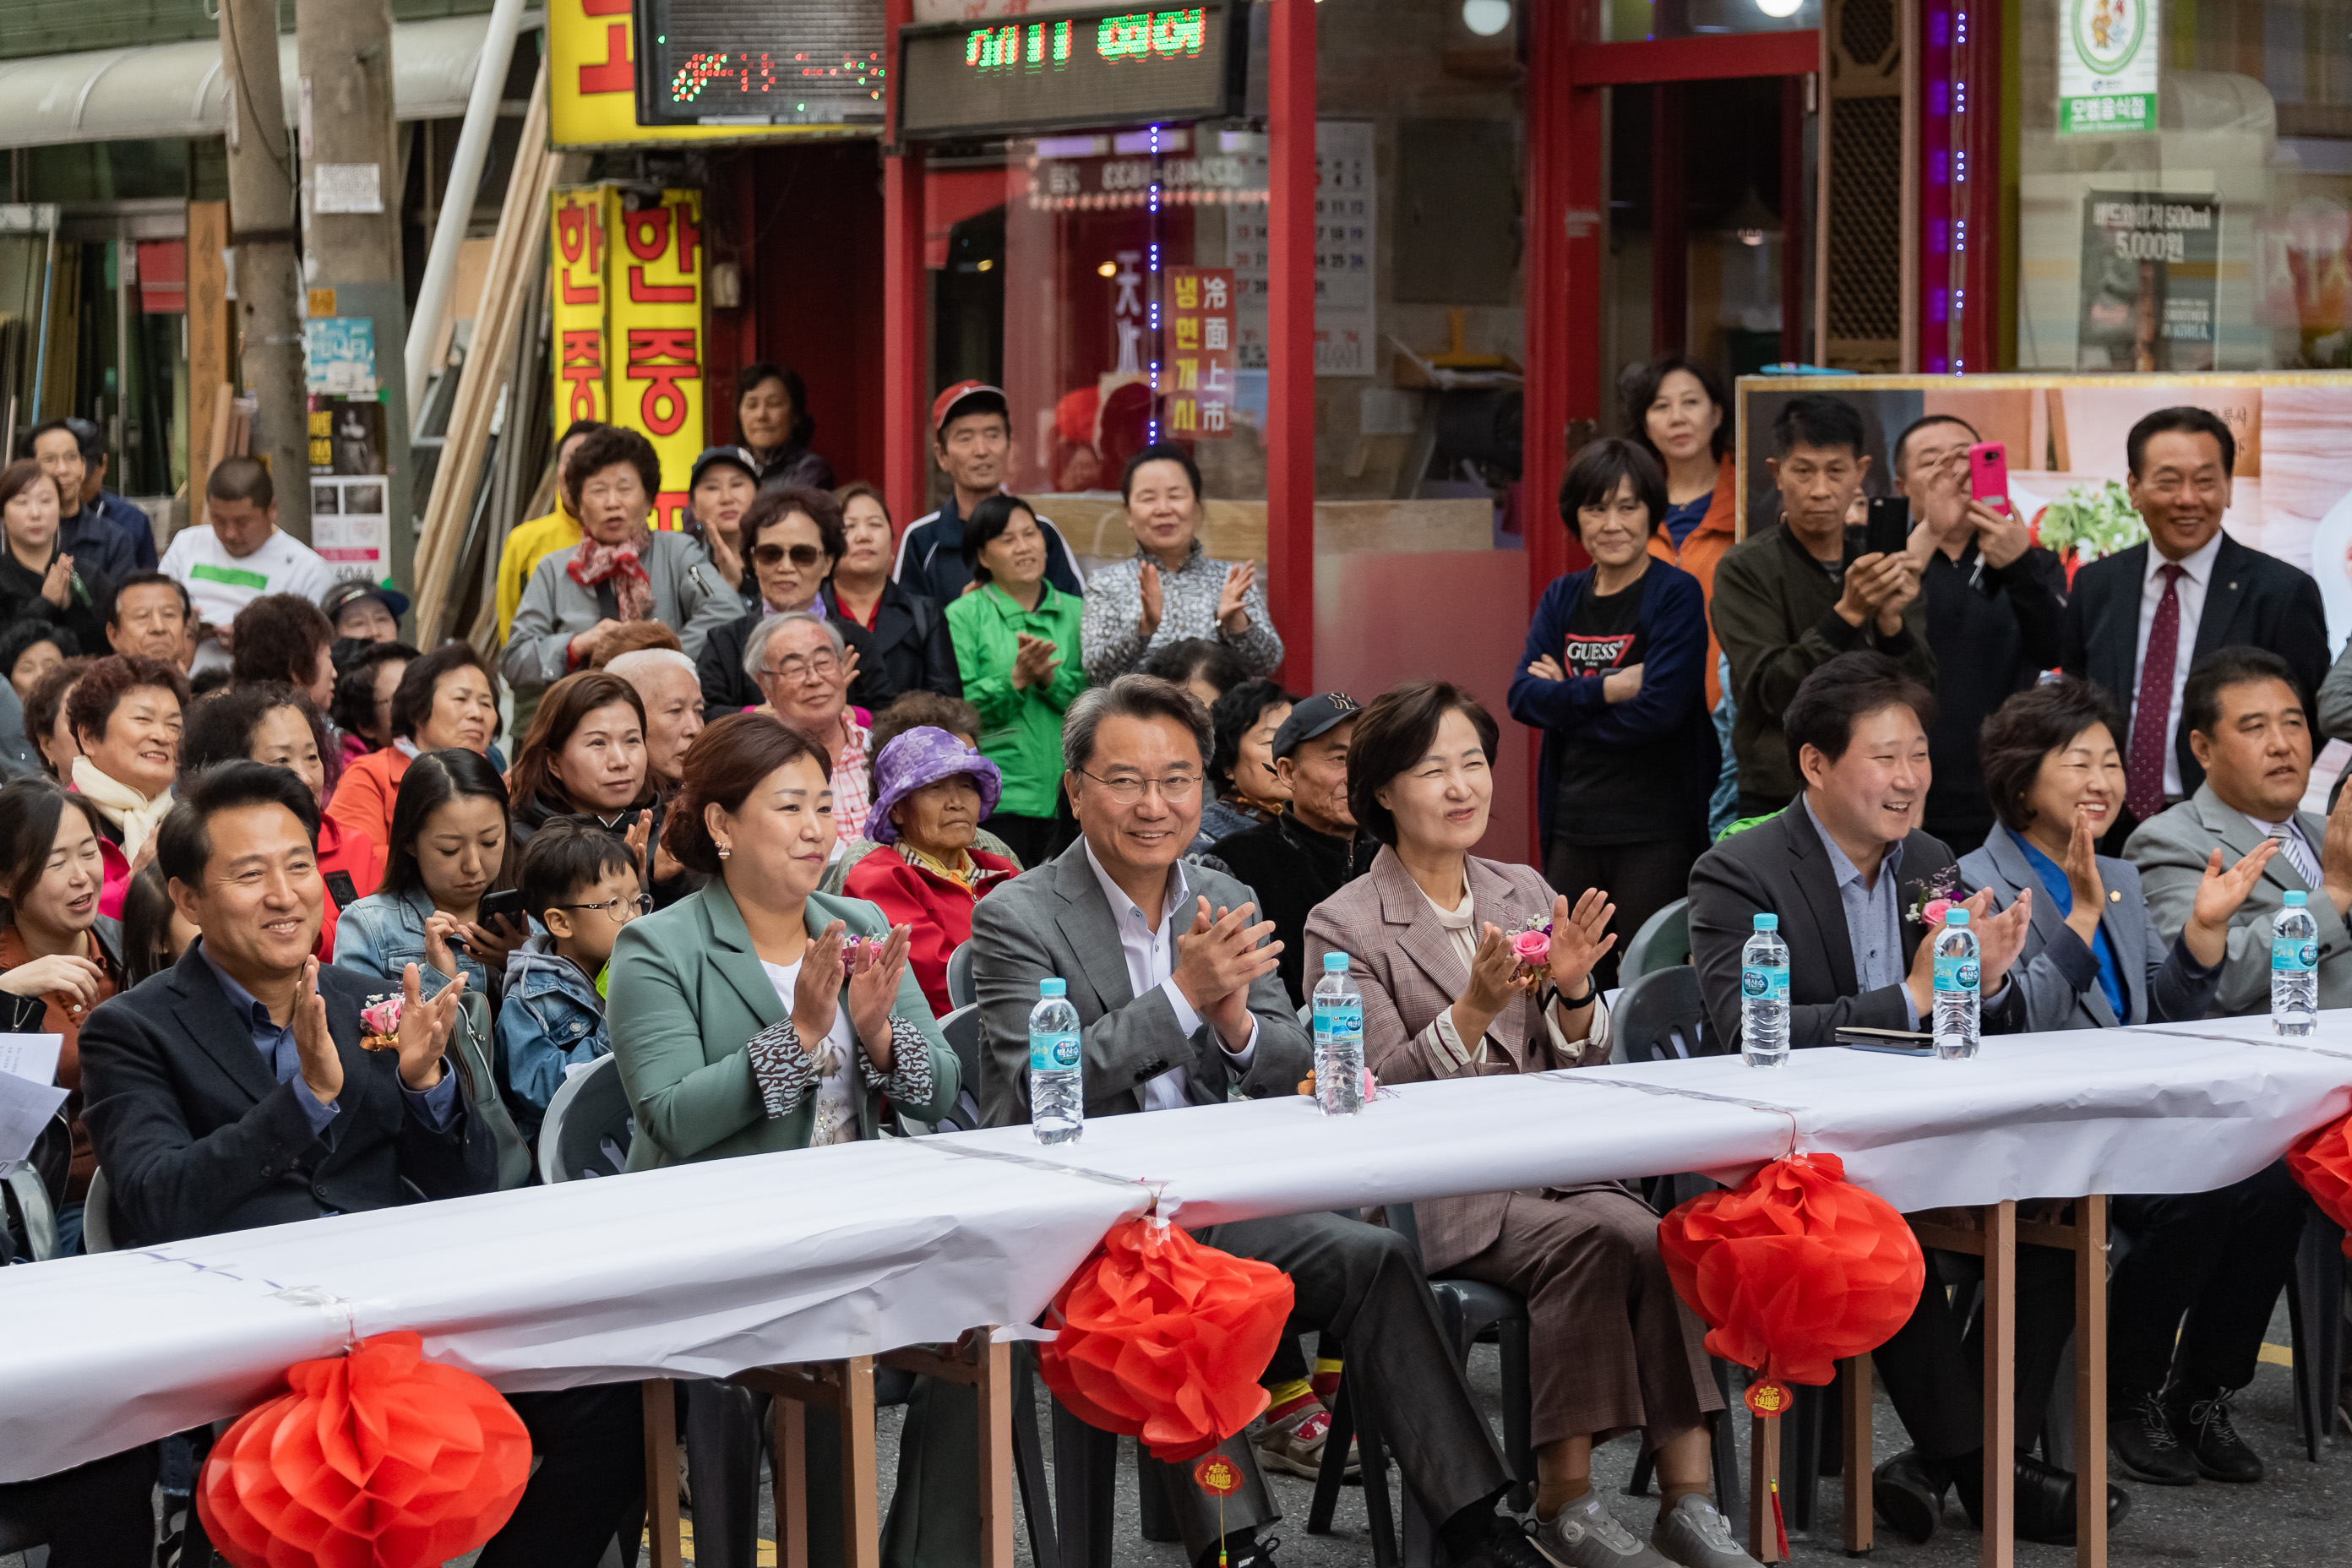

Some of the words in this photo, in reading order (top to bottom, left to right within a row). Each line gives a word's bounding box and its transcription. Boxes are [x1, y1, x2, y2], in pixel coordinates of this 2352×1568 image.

[2071, 95, 2145, 122] 모범음식점
[2164, 204, 2211, 229] 500ml
[1172, 275, 1199, 432] 냉면개시
[1202, 275, 1229, 433] 冷面上市
[1567, 642, 1618, 661] GUESS
[1745, 977, 1766, 988] 백산수
[1056, 1046, 1080, 1059] 백산수
